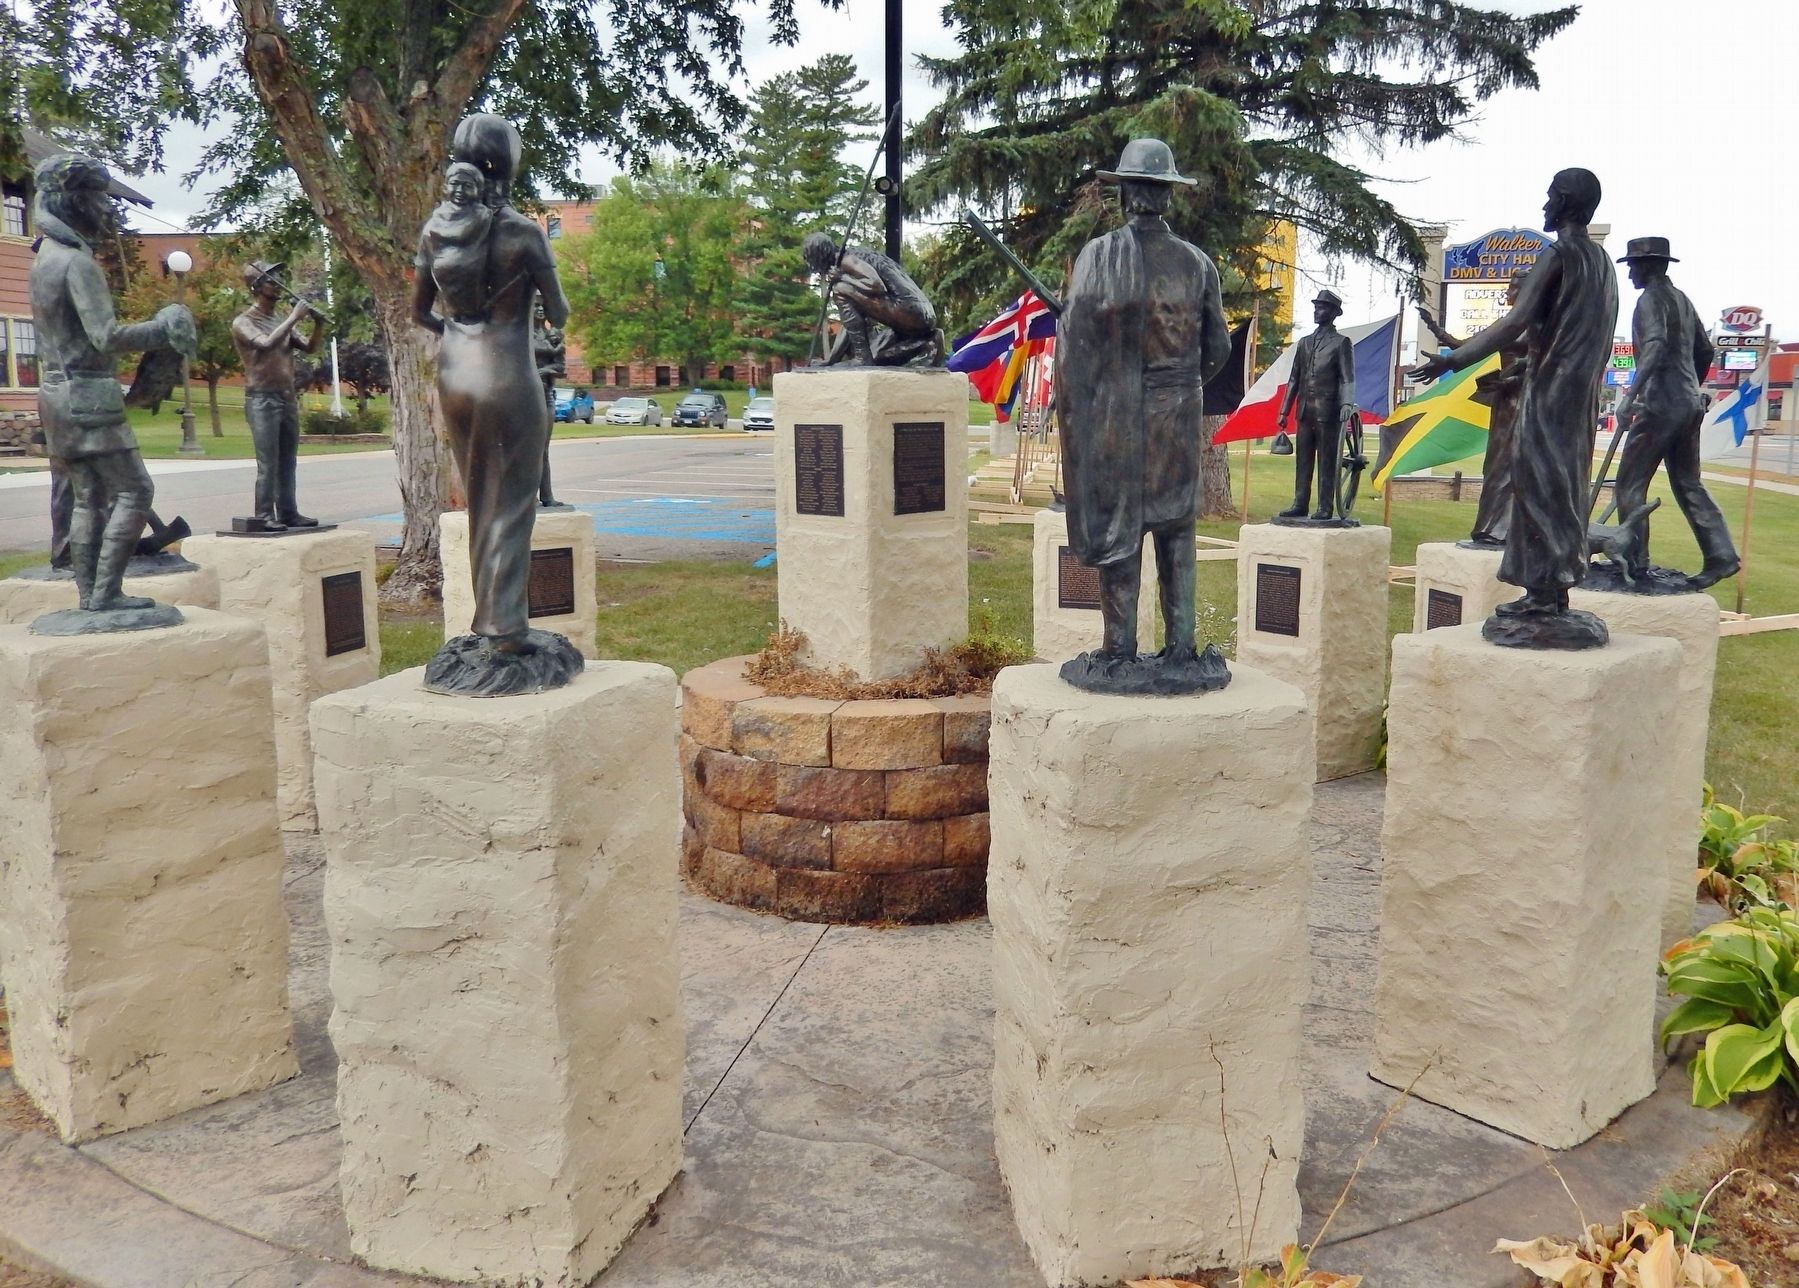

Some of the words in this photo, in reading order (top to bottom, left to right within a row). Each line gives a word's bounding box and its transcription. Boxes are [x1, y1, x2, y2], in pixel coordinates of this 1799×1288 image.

[1485, 234, 1543, 252] Walker
[1480, 254, 1509, 265] CITY
[1450, 267, 1482, 278] DMV
[1487, 267, 1497, 278] &
[1731, 312, 1757, 326] DQ
[1718, 337, 1739, 346] Grill
